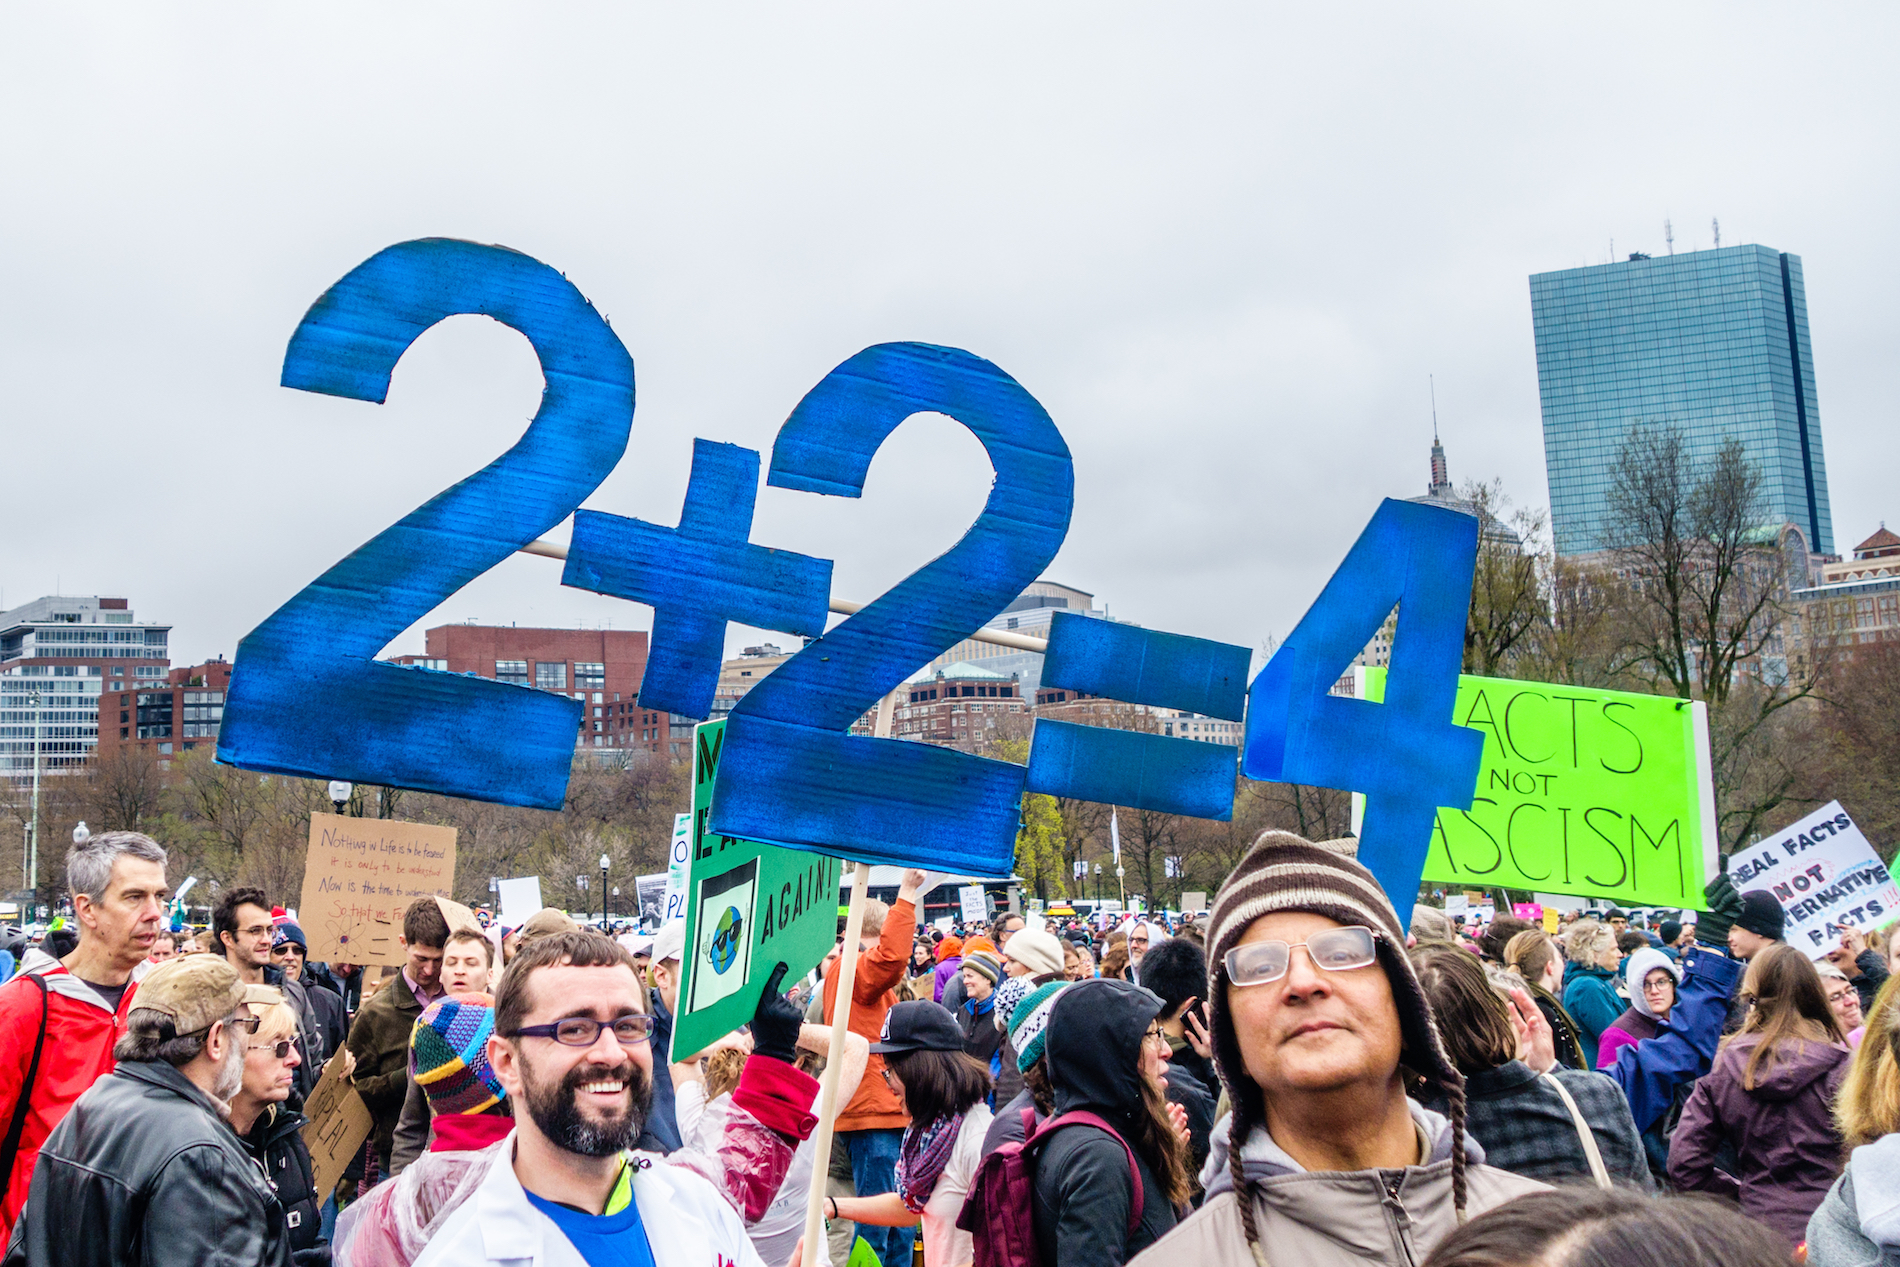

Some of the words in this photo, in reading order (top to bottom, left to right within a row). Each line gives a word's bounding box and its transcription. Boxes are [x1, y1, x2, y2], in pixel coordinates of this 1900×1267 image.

[1458, 686, 1643, 774] ACTS
[1490, 768, 1558, 796] NOT
[344, 858, 352, 868] is
[382, 860, 390, 873] to
[396, 862, 405, 874] be
[380, 838, 397, 855] Life
[398, 843, 405, 854] is
[414, 840, 422, 856] be
[1433, 797, 1685, 898] ASCISM
[1729, 851, 1779, 888] REAL
[1781, 813, 1850, 856] FACTS
[318, 876, 342, 892] Now
[348, 879, 356, 892] is
[362, 881, 375, 895] the
[378, 883, 393, 896] time
[396, 884, 403, 896] to
[761, 856, 833, 945] AGAIN!
[1772, 863, 1825, 902] NOT
[1784, 864, 1890, 928] TERNATIVE
[328, 900, 347, 918] So
[1807, 899, 1884, 947] FACTS
[313, 1078, 348, 1161] REPEAL
